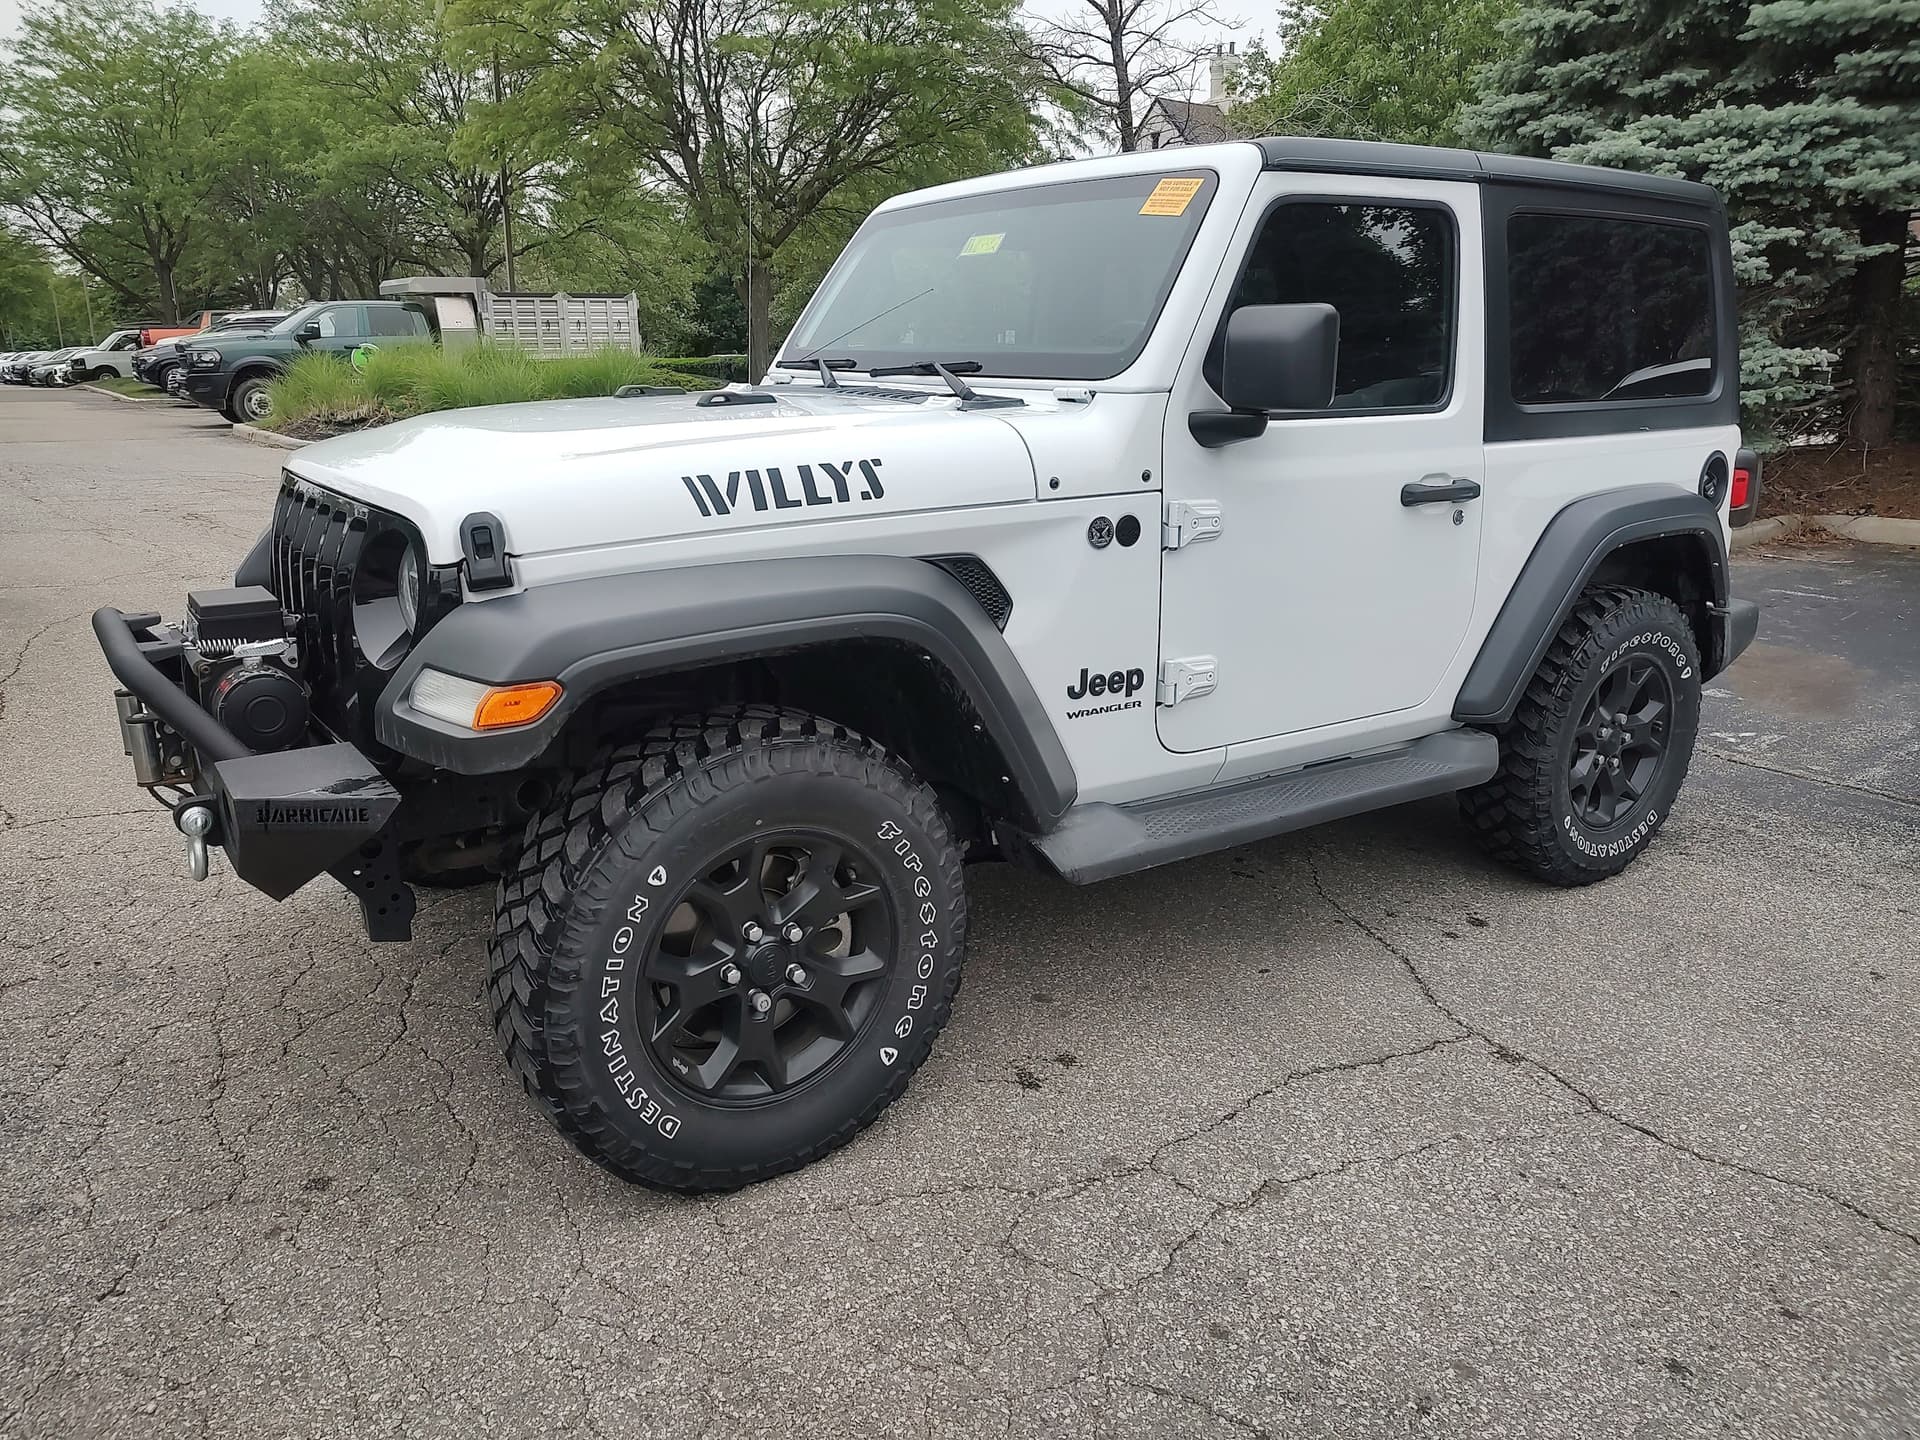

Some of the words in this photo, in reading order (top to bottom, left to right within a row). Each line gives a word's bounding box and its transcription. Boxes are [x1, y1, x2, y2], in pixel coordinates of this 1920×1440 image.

[681, 458, 885, 517] WILLYS
[1067, 667, 1144, 700] Jeep
[1066, 700, 1142, 719] WRANGLER
[256, 807, 369, 824] BARRICADE
[1569, 810, 1658, 858] DESTINATION
[877, 820, 939, 1039] Firestone
[600, 896, 681, 1139] DESTINATION
